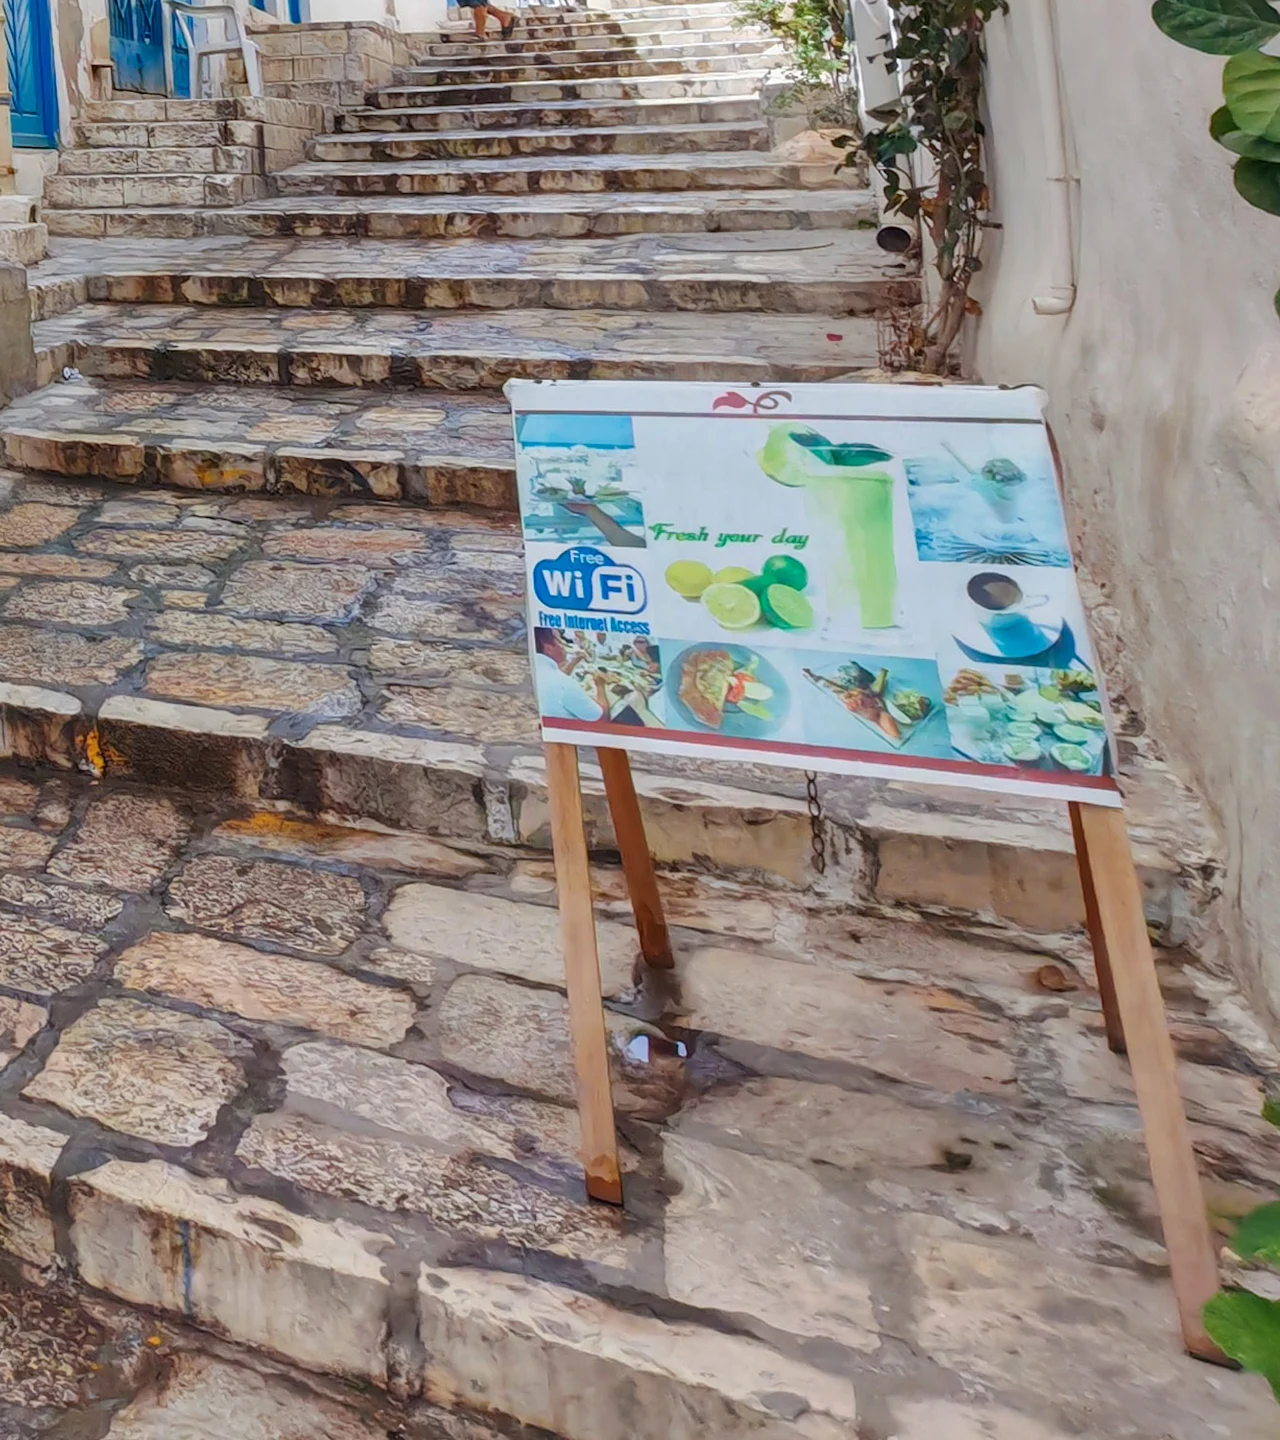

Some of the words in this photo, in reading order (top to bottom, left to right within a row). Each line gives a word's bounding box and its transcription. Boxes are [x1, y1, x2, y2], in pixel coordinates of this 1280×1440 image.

[648, 523, 710, 542] Fresh
[715, 532, 764, 547] your
[771, 527, 810, 550] day
[569, 550, 605, 565] Free
[538, 611, 561, 627] Free
[564, 613, 608, 631] Internet
[610, 617, 650, 635] Access
